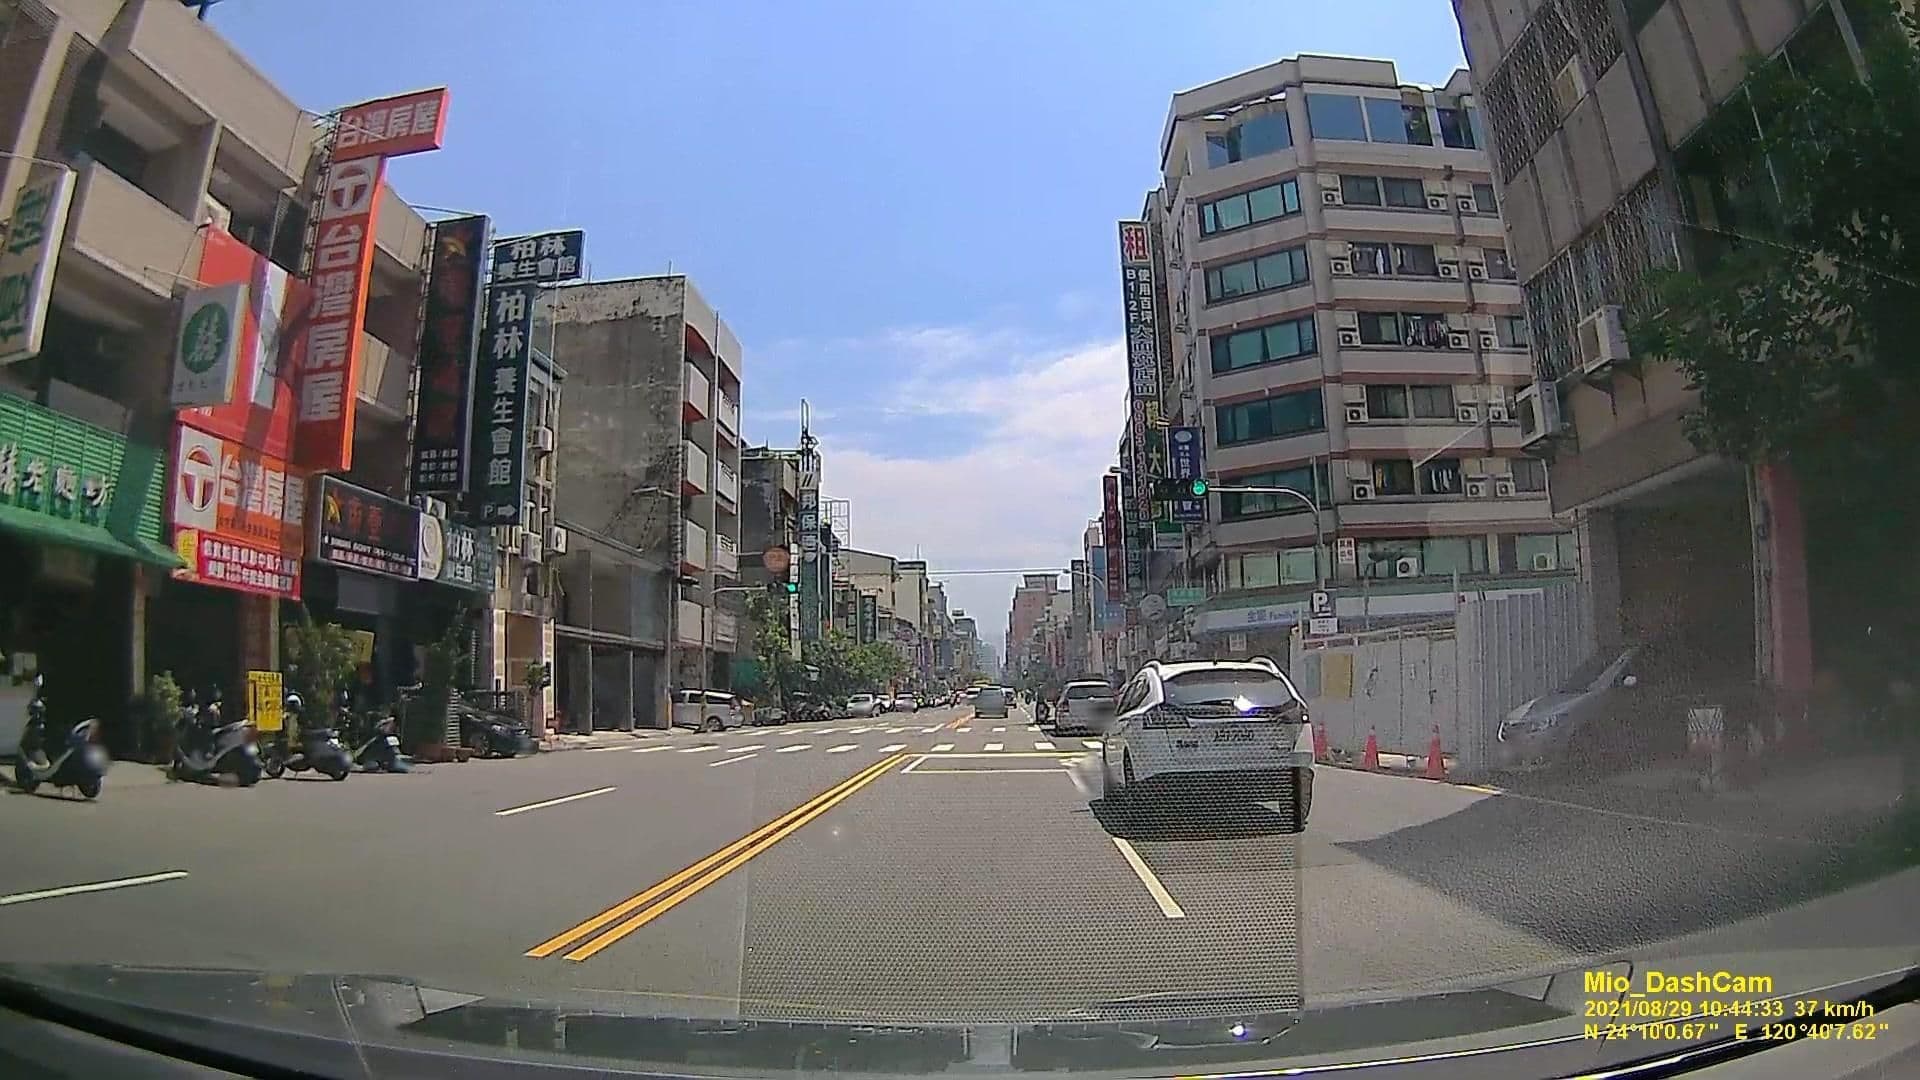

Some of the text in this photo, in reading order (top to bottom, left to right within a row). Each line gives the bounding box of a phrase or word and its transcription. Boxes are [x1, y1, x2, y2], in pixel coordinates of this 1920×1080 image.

[510, 236, 567, 260] 柏林
[1124, 227, 1148, 261] 租
[497, 256, 576, 281] 養生會館
[301, 223, 363, 422] 台灣房屋
[487, 289, 528, 485] 柏林養生會館
[219, 453, 303, 524] 台灣房屋
[1313, 592, 1328, 613] P
